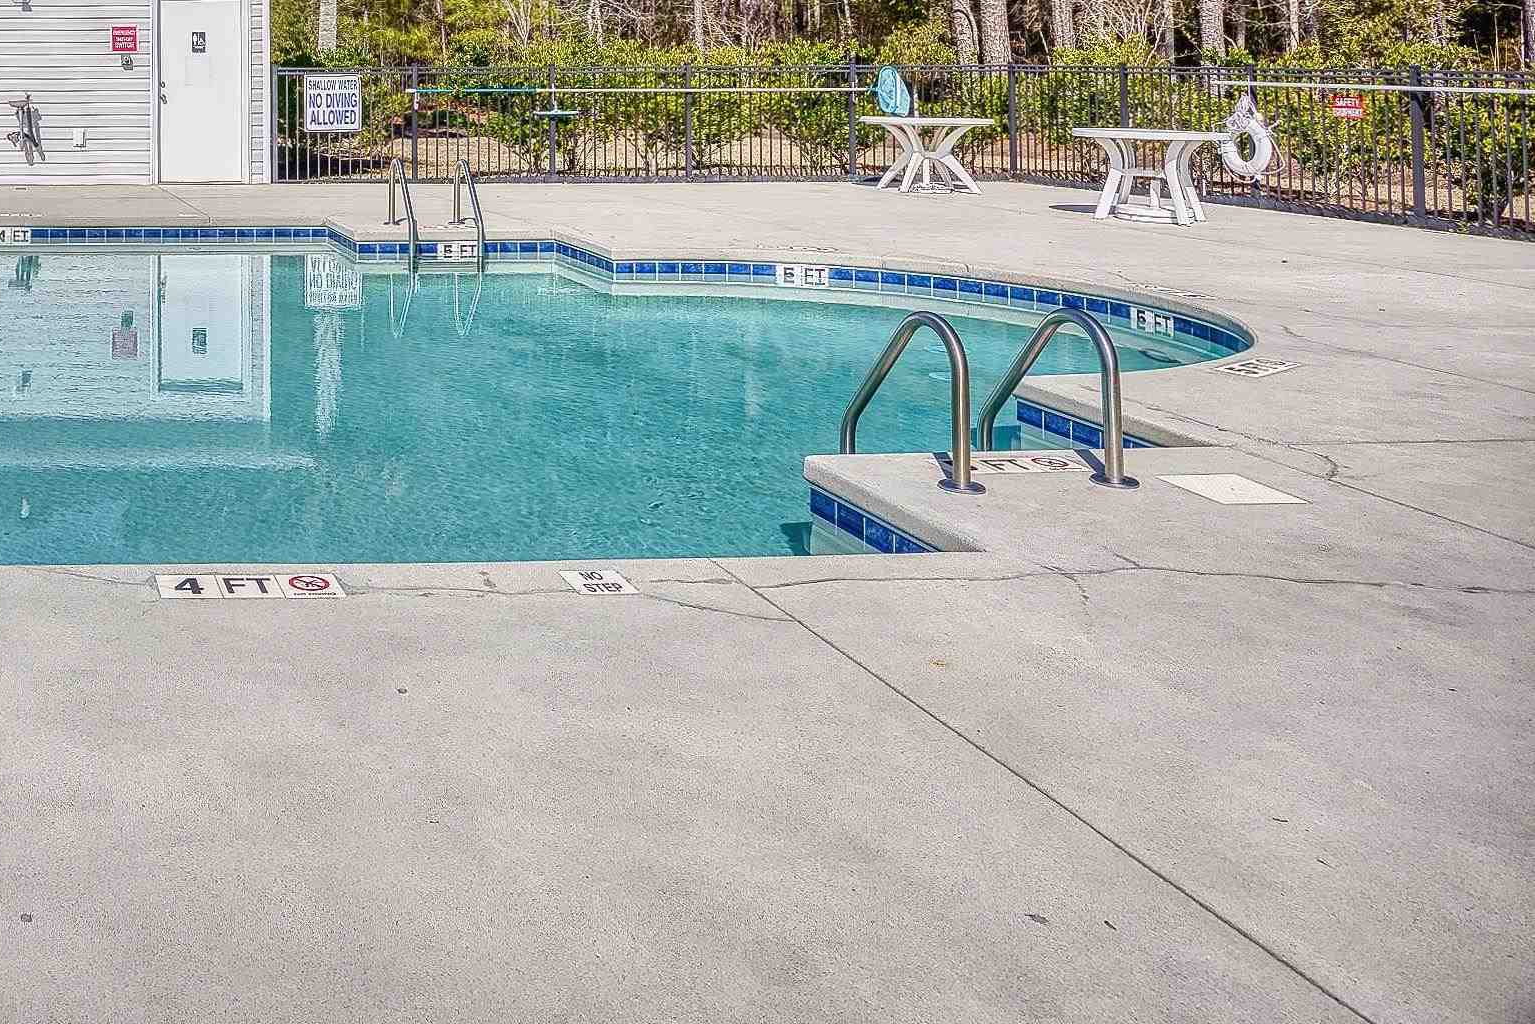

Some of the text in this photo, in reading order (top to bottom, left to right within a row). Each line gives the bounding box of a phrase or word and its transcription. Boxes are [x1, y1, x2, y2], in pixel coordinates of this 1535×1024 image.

[308, 80, 358, 90] SHALLOW WATER
[309, 93, 358, 108] NO DIVING
[310, 110, 357, 125] ALLOWED
[979, 459, 1031, 471] FT
[578, 571, 603, 581] NO
[174, 578, 271, 595] 4 FT
[583, 583, 623, 592] STEP
